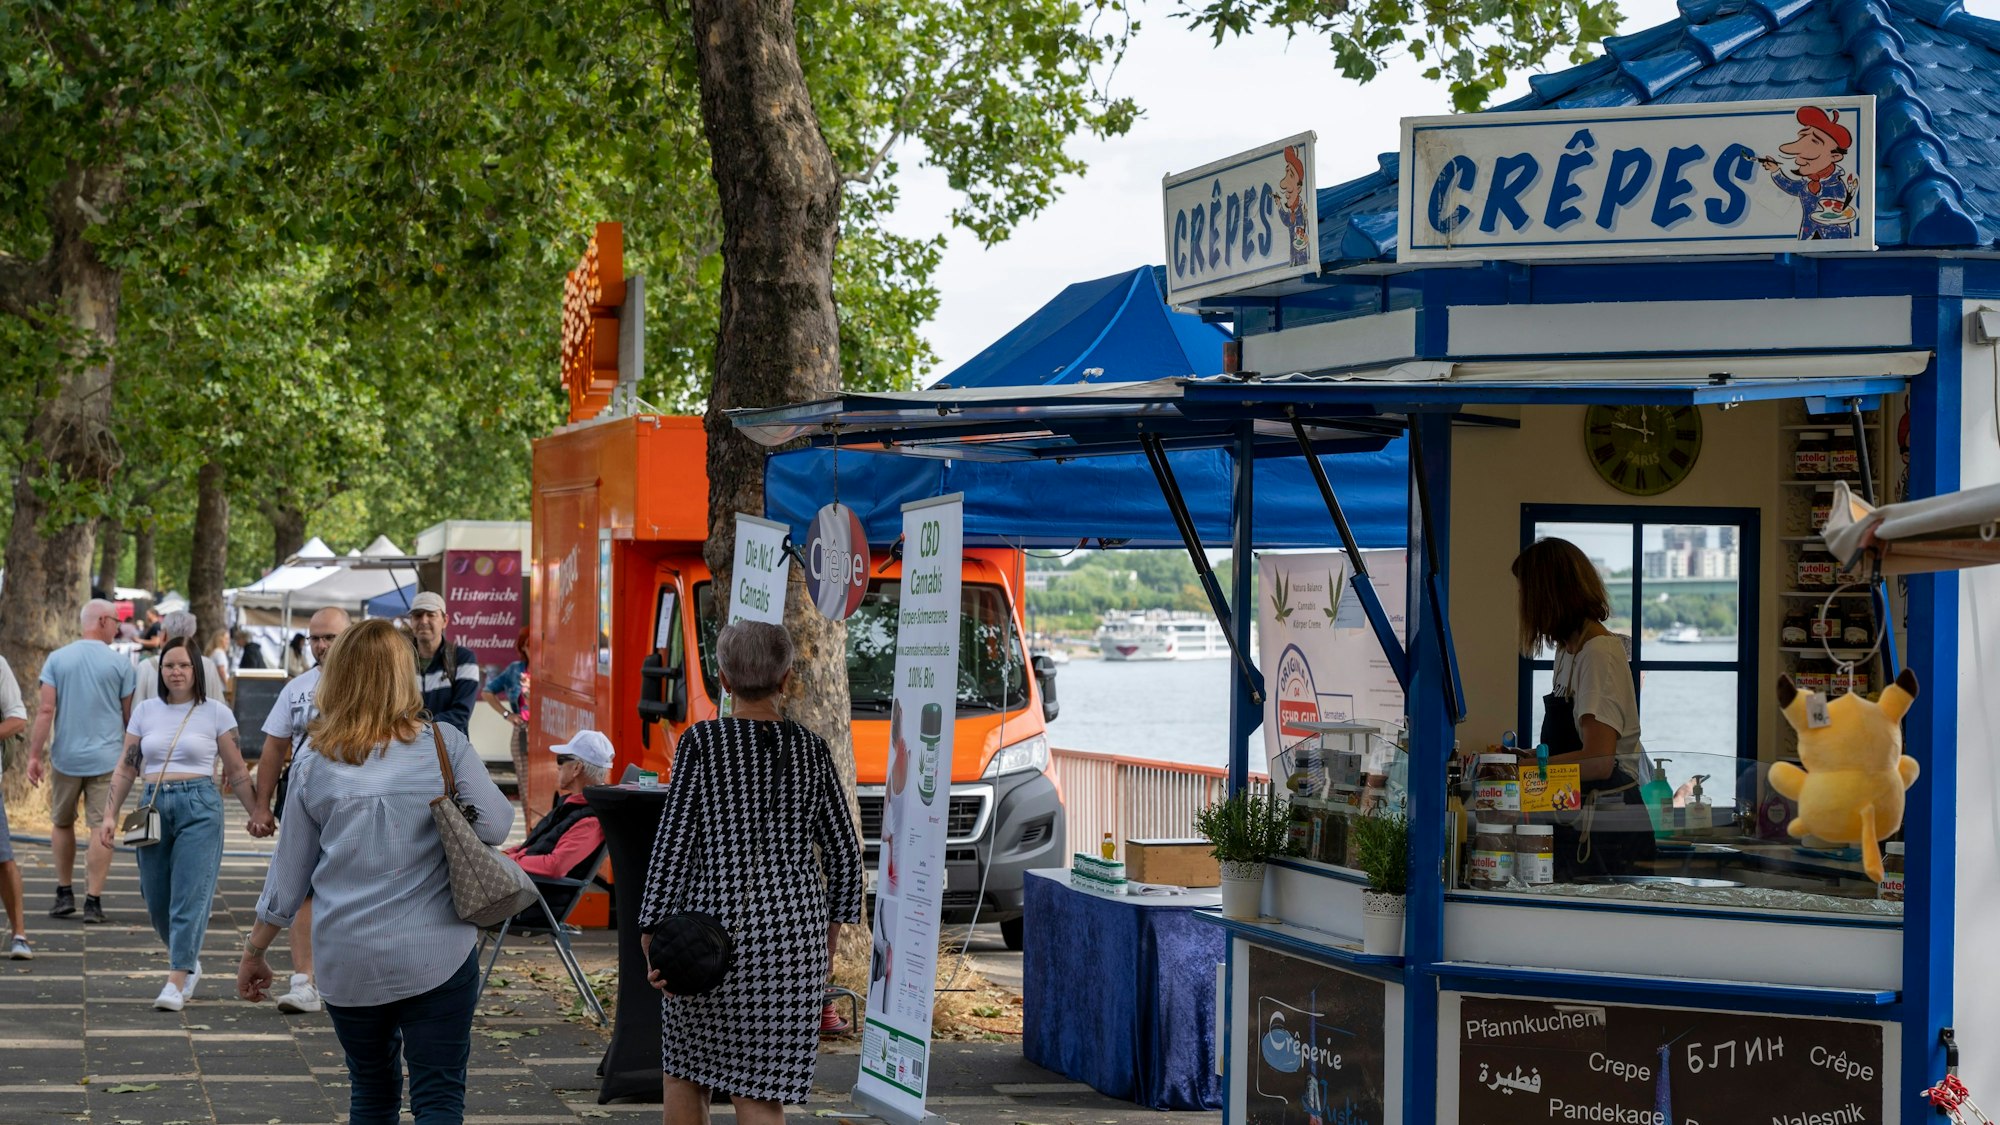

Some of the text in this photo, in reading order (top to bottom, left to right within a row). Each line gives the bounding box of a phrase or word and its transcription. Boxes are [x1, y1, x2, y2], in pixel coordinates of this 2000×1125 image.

[1428, 128, 1757, 234] CRÊPES
[1173, 179, 1273, 279] CRÊPES
[1626, 451, 1660, 466] PARIS
[1797, 453, 1826, 462] nutella
[1813, 510, 1830, 519] nute
[920, 520, 940, 558] CBD
[745, 539, 774, 573] Die Nr.1
[810, 537, 864, 596] Crêpe
[1799, 564, 1831, 573] nutella
[450, 587, 518, 602] Historische
[910, 568, 943, 595] Cannabis
[739, 578, 771, 613] Cannabis
[1297, 601, 1316, 611] Cannabis
[452, 611, 516, 628] Senfmühle
[455, 634, 515, 648] Monschau
[908, 667, 935, 688] 100% Bio
[1280, 656, 1310, 693] ORIGINAL
[1281, 709, 1318, 725] SEHR GUT
[1472, 856, 1497, 868] utella
[1880, 880, 1905, 891] nutel
[1466, 1009, 1599, 1040] Pfannkuchen
[1269, 1011, 1342, 1070] Crêperie
[1589, 1052, 1651, 1082] Crepe
[1687, 1036, 1785, 1074] БЛИН
[1809, 1045, 1875, 1081] Crêpe
[1478, 1062, 1542, 1095] فطيرة
[1549, 1098, 1665, 1125] Pandekage
